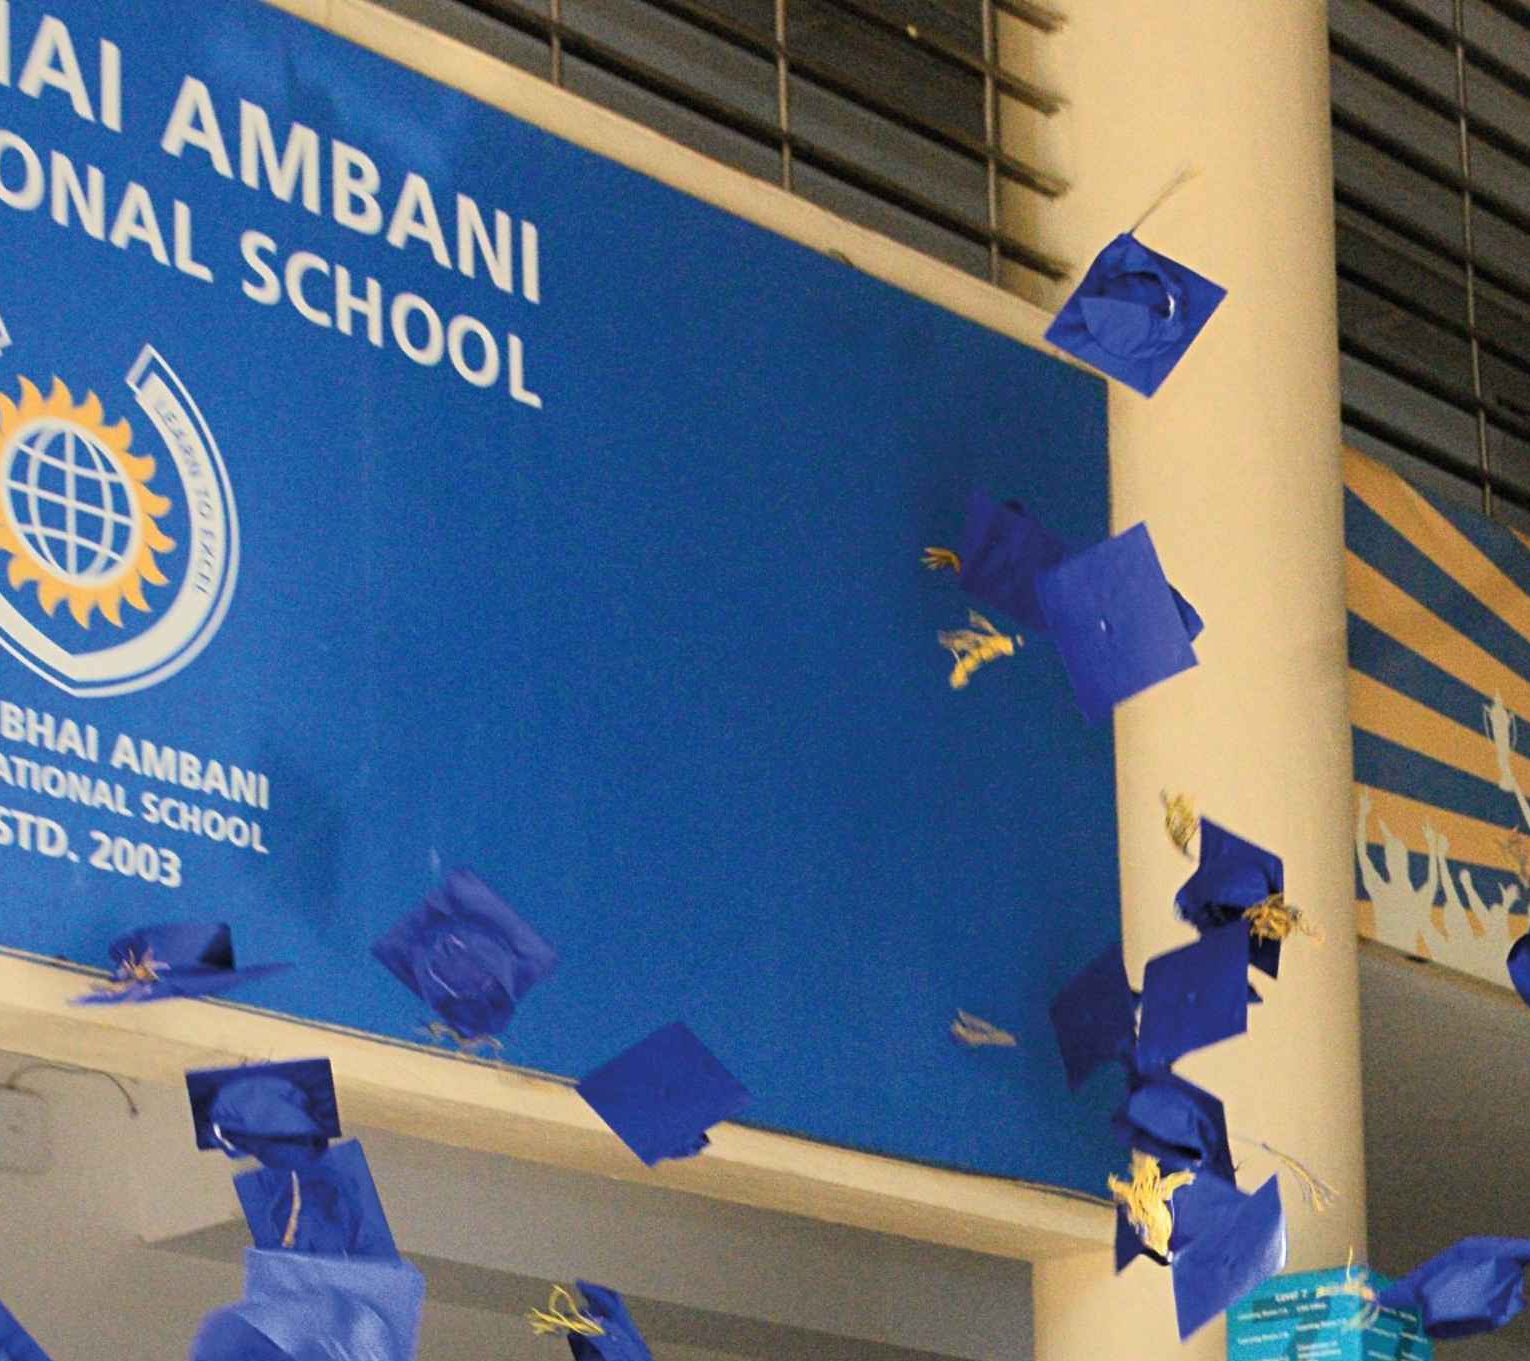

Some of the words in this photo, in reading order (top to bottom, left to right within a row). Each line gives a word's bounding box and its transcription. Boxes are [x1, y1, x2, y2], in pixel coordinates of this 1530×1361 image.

[160, 75, 541, 305] AMBANI
[239, 230, 542, 409] SCHOOL
[193, 482, 215, 518] TO
[110, 733, 270, 811] AMBANI
[141, 791, 270, 855] SCHOOL
[89, 829, 183, 889] 2003
